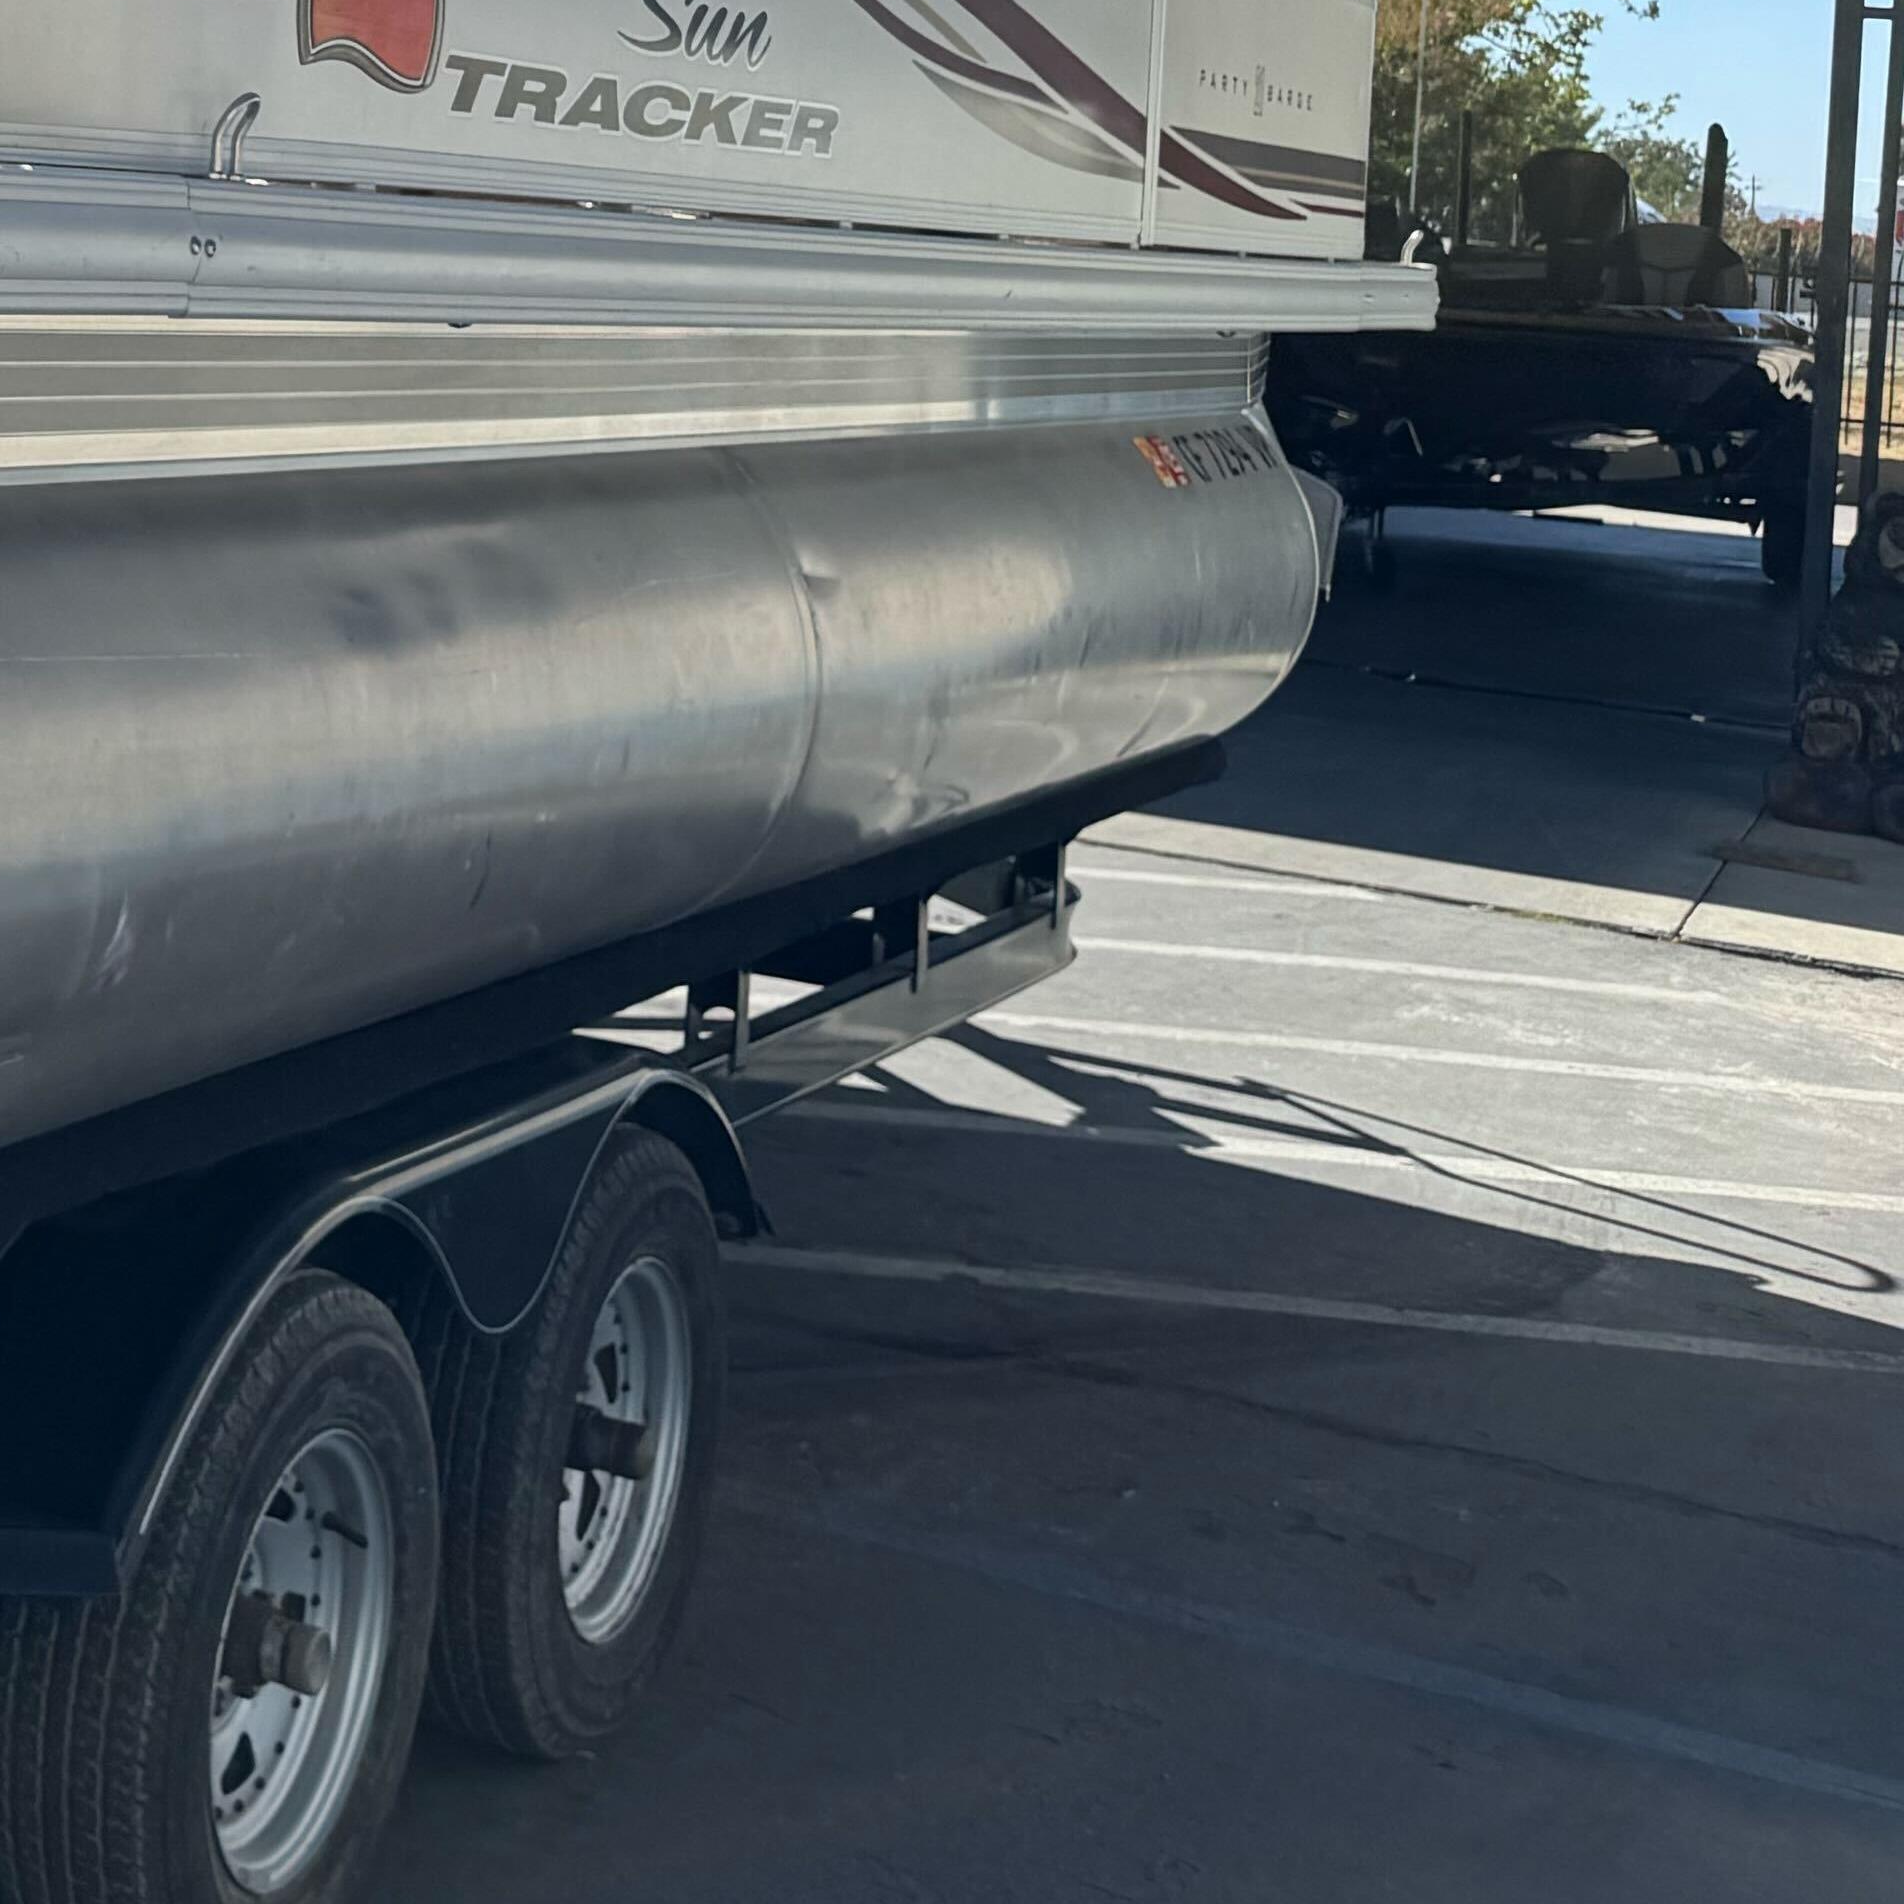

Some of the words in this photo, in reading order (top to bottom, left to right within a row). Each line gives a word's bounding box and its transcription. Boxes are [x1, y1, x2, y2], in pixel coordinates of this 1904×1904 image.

[444, 52, 840, 157] TRACKER
[1199, 69, 1248, 97] PARTY
[1266, 84, 1313, 111] BARGE
